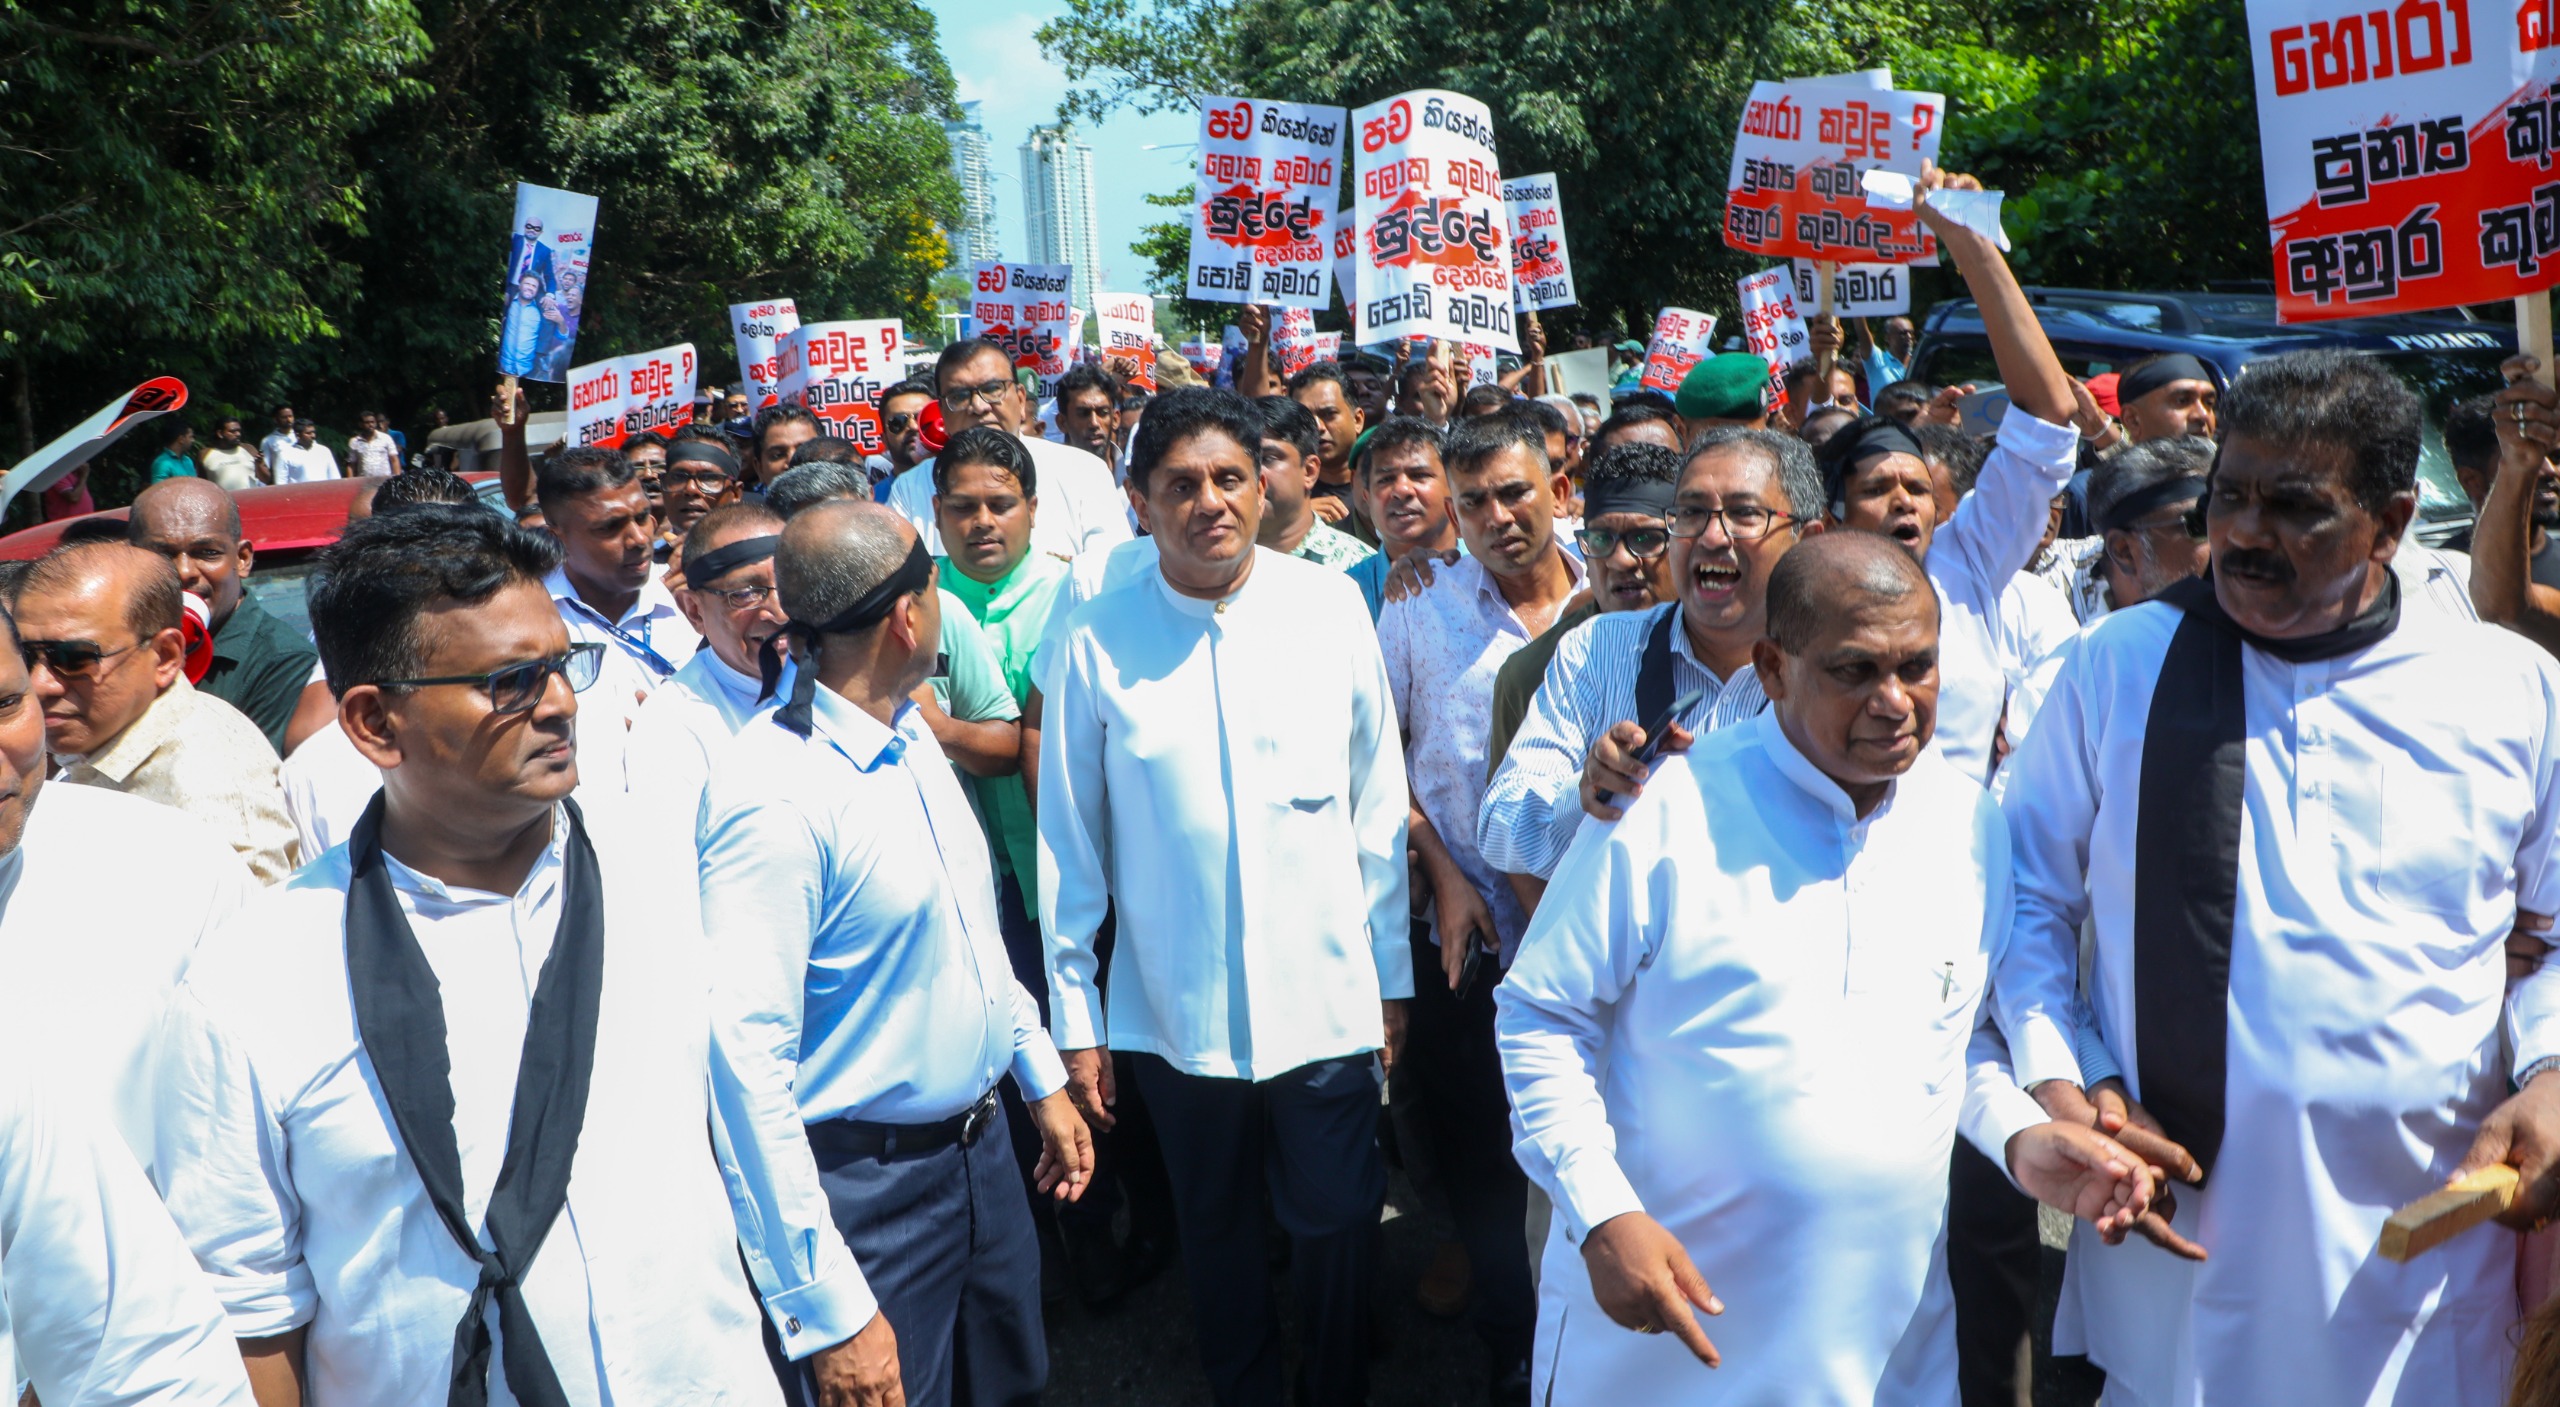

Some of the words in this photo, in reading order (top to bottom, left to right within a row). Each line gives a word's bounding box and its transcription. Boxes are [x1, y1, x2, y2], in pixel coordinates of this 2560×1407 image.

[1208, 102, 1254, 141] පච
[1261, 107, 1337, 147] කියන්නේ
[1362, 98, 1413, 153] පච
[1818, 101, 1891, 160] කවුද
[1912, 104, 1934, 150] ?
[1205, 153, 1262, 186] ලොකු
[1273, 156, 1333, 190] කුමාර
[1365, 157, 1431, 200] ලොකු
[1447, 157, 1503, 202] කුමාර
[1210, 192, 1312, 242] සුද්දේ
[1375, 197, 1494, 262] සුද්දේ
[1518, 206, 1557, 234] කුමාර
[1729, 204, 1782, 245] අනුර
[1254, 242, 1324, 267] දෙන්නේ
[2288, 203, 2442, 305] අනුර
[977, 264, 1007, 293] පච
[1011, 267, 1067, 293] කියන්නේ
[1197, 262, 1252, 291] පොඩි
[1262, 267, 1321, 299] කුමාර
[1432, 262, 1508, 292] දෙන්නේ
[976, 302, 1014, 326] ලොකු
[1023, 300, 1066, 327] කුමාර
[1367, 282, 1432, 330] පොඩි
[1448, 293, 1510, 336] කුමාර
[1697, 319, 1711, 339] ?
[807, 332, 869, 372] කවුද
[881, 328, 897, 362] ?
[2386, 333, 2502, 350] POLICE
[573, 368, 618, 411] හොරා
[631, 359, 673, 401] කවුද
[682, 351, 692, 384] ?
